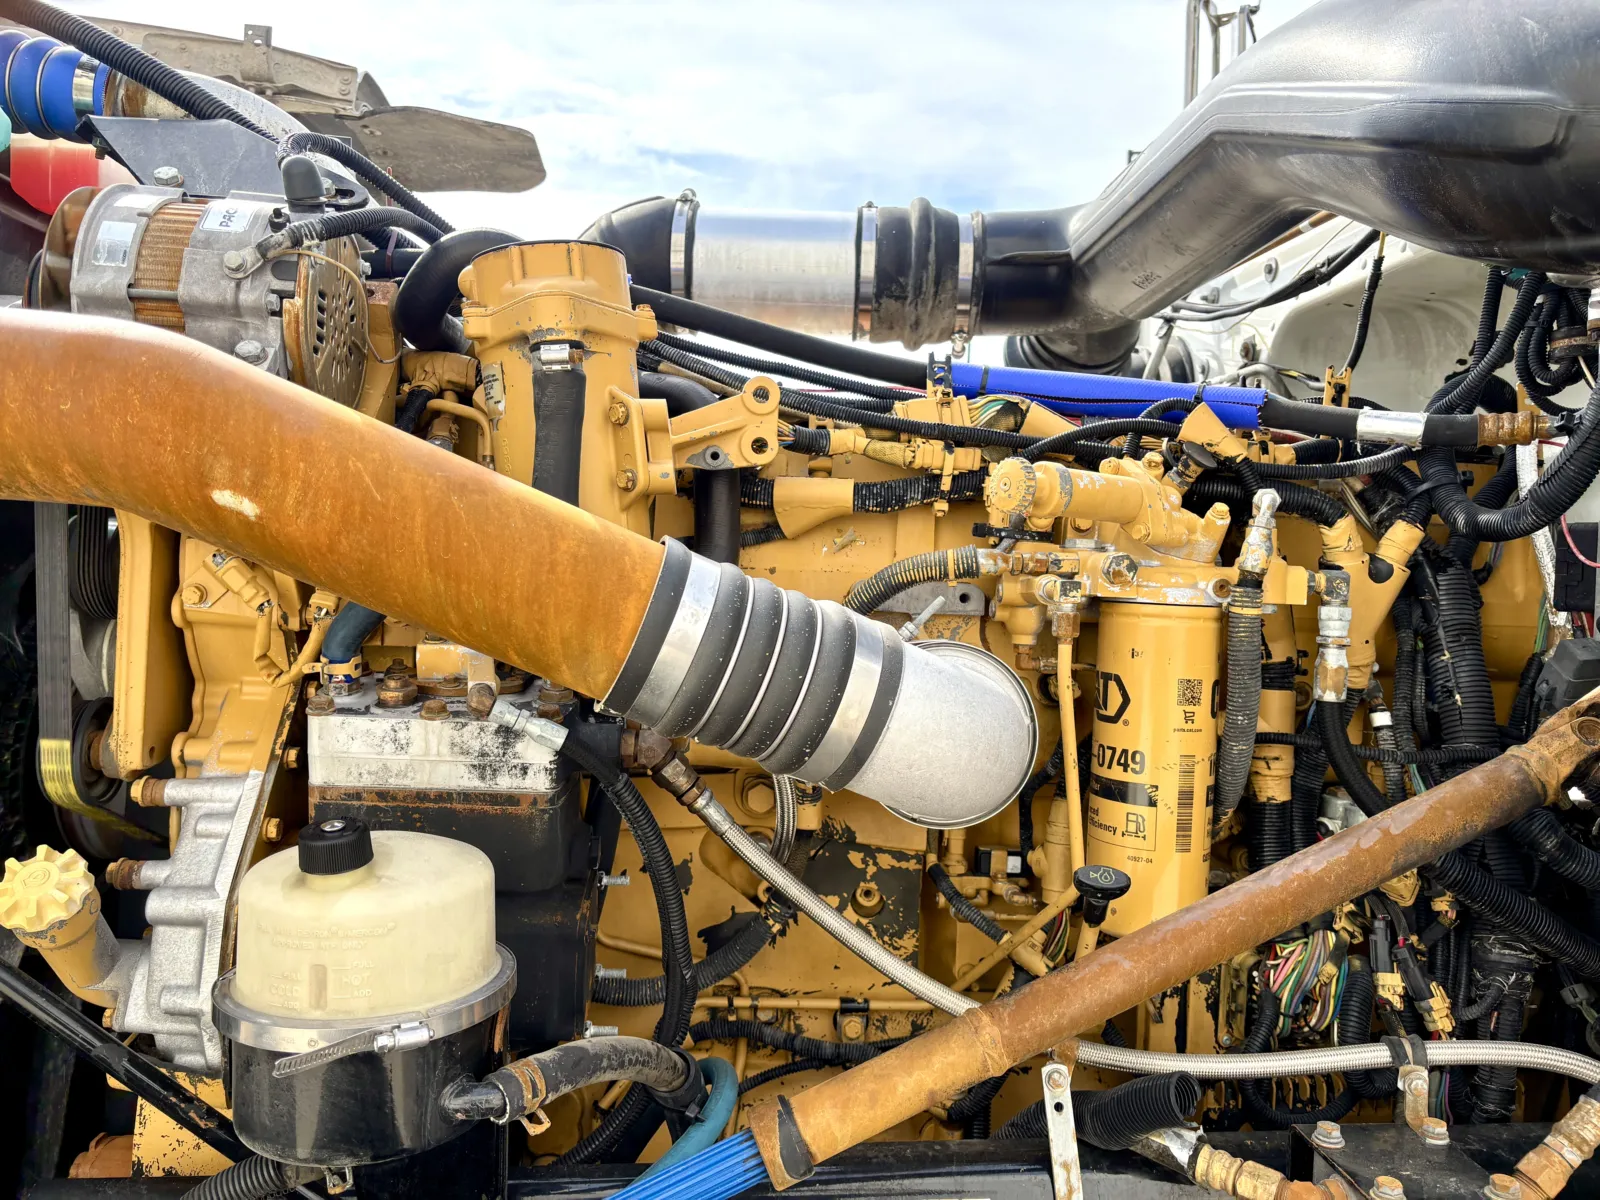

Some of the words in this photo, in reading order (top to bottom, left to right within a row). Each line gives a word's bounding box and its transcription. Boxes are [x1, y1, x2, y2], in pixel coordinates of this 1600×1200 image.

[1092, 744, 1146, 775] -0749
[1127, 855, 1153, 864] 40927-04
[353, 960, 375, 969] FULL
[270, 984, 302, 998] COLD
[354, 990, 373, 998] ADD
